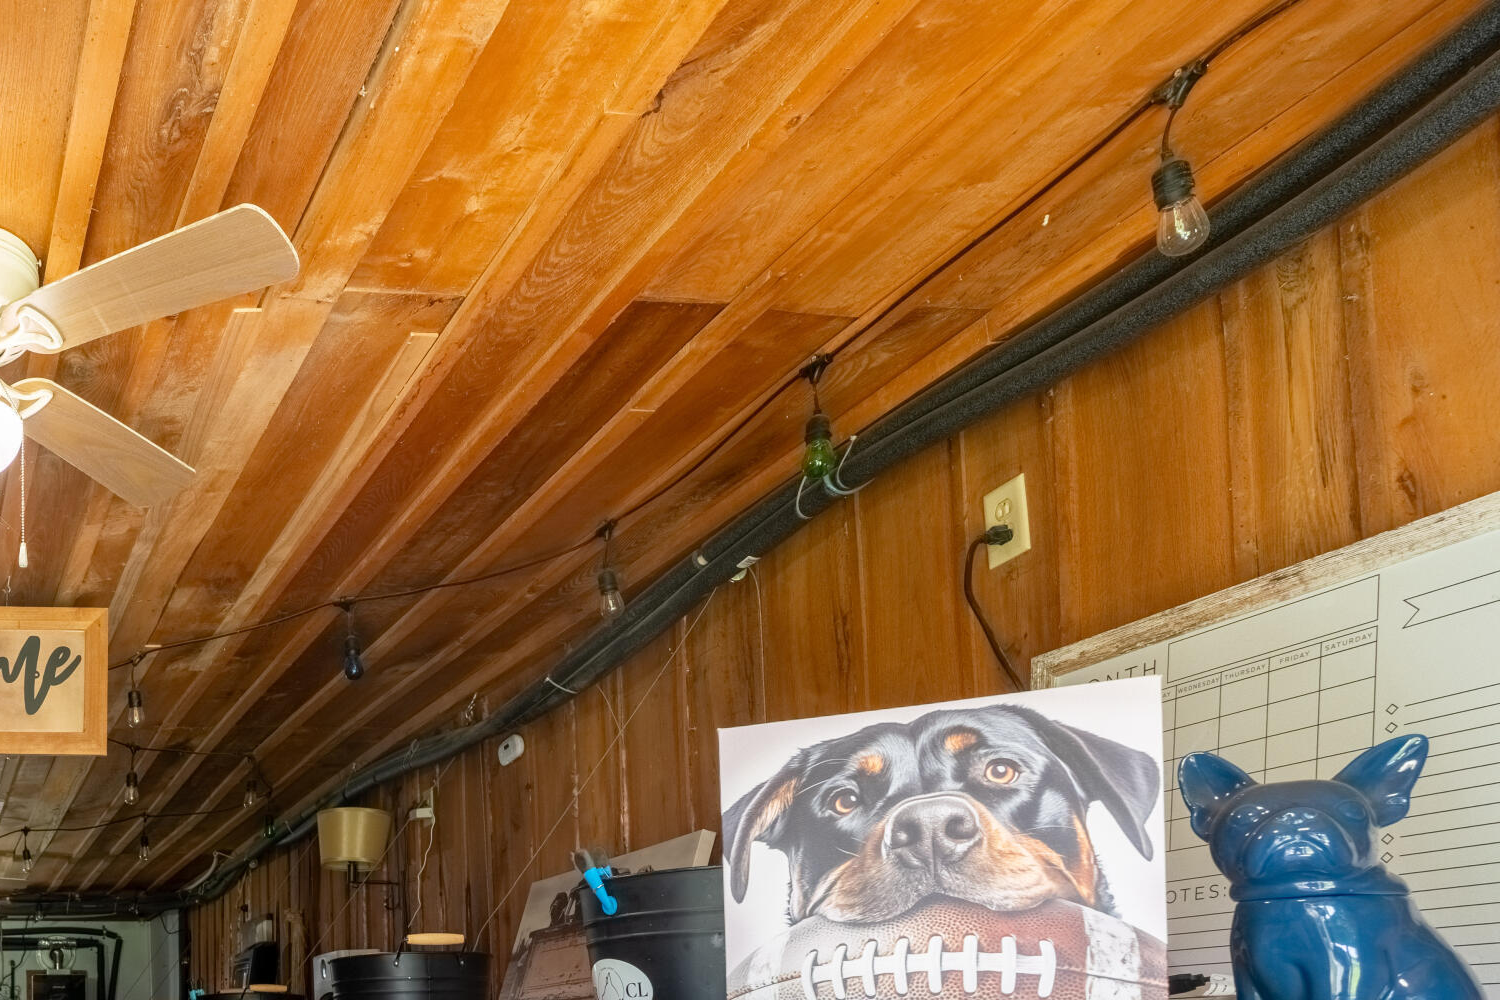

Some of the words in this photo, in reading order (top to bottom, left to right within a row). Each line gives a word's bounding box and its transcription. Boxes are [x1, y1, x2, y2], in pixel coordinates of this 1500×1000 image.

[1224, 663, 1266, 681] THURSDAY
[1279, 650, 1311, 665] FRIDAY
[1324, 632, 1373, 651] SATURDAY
[1167, 884, 1227, 904] OTES:
